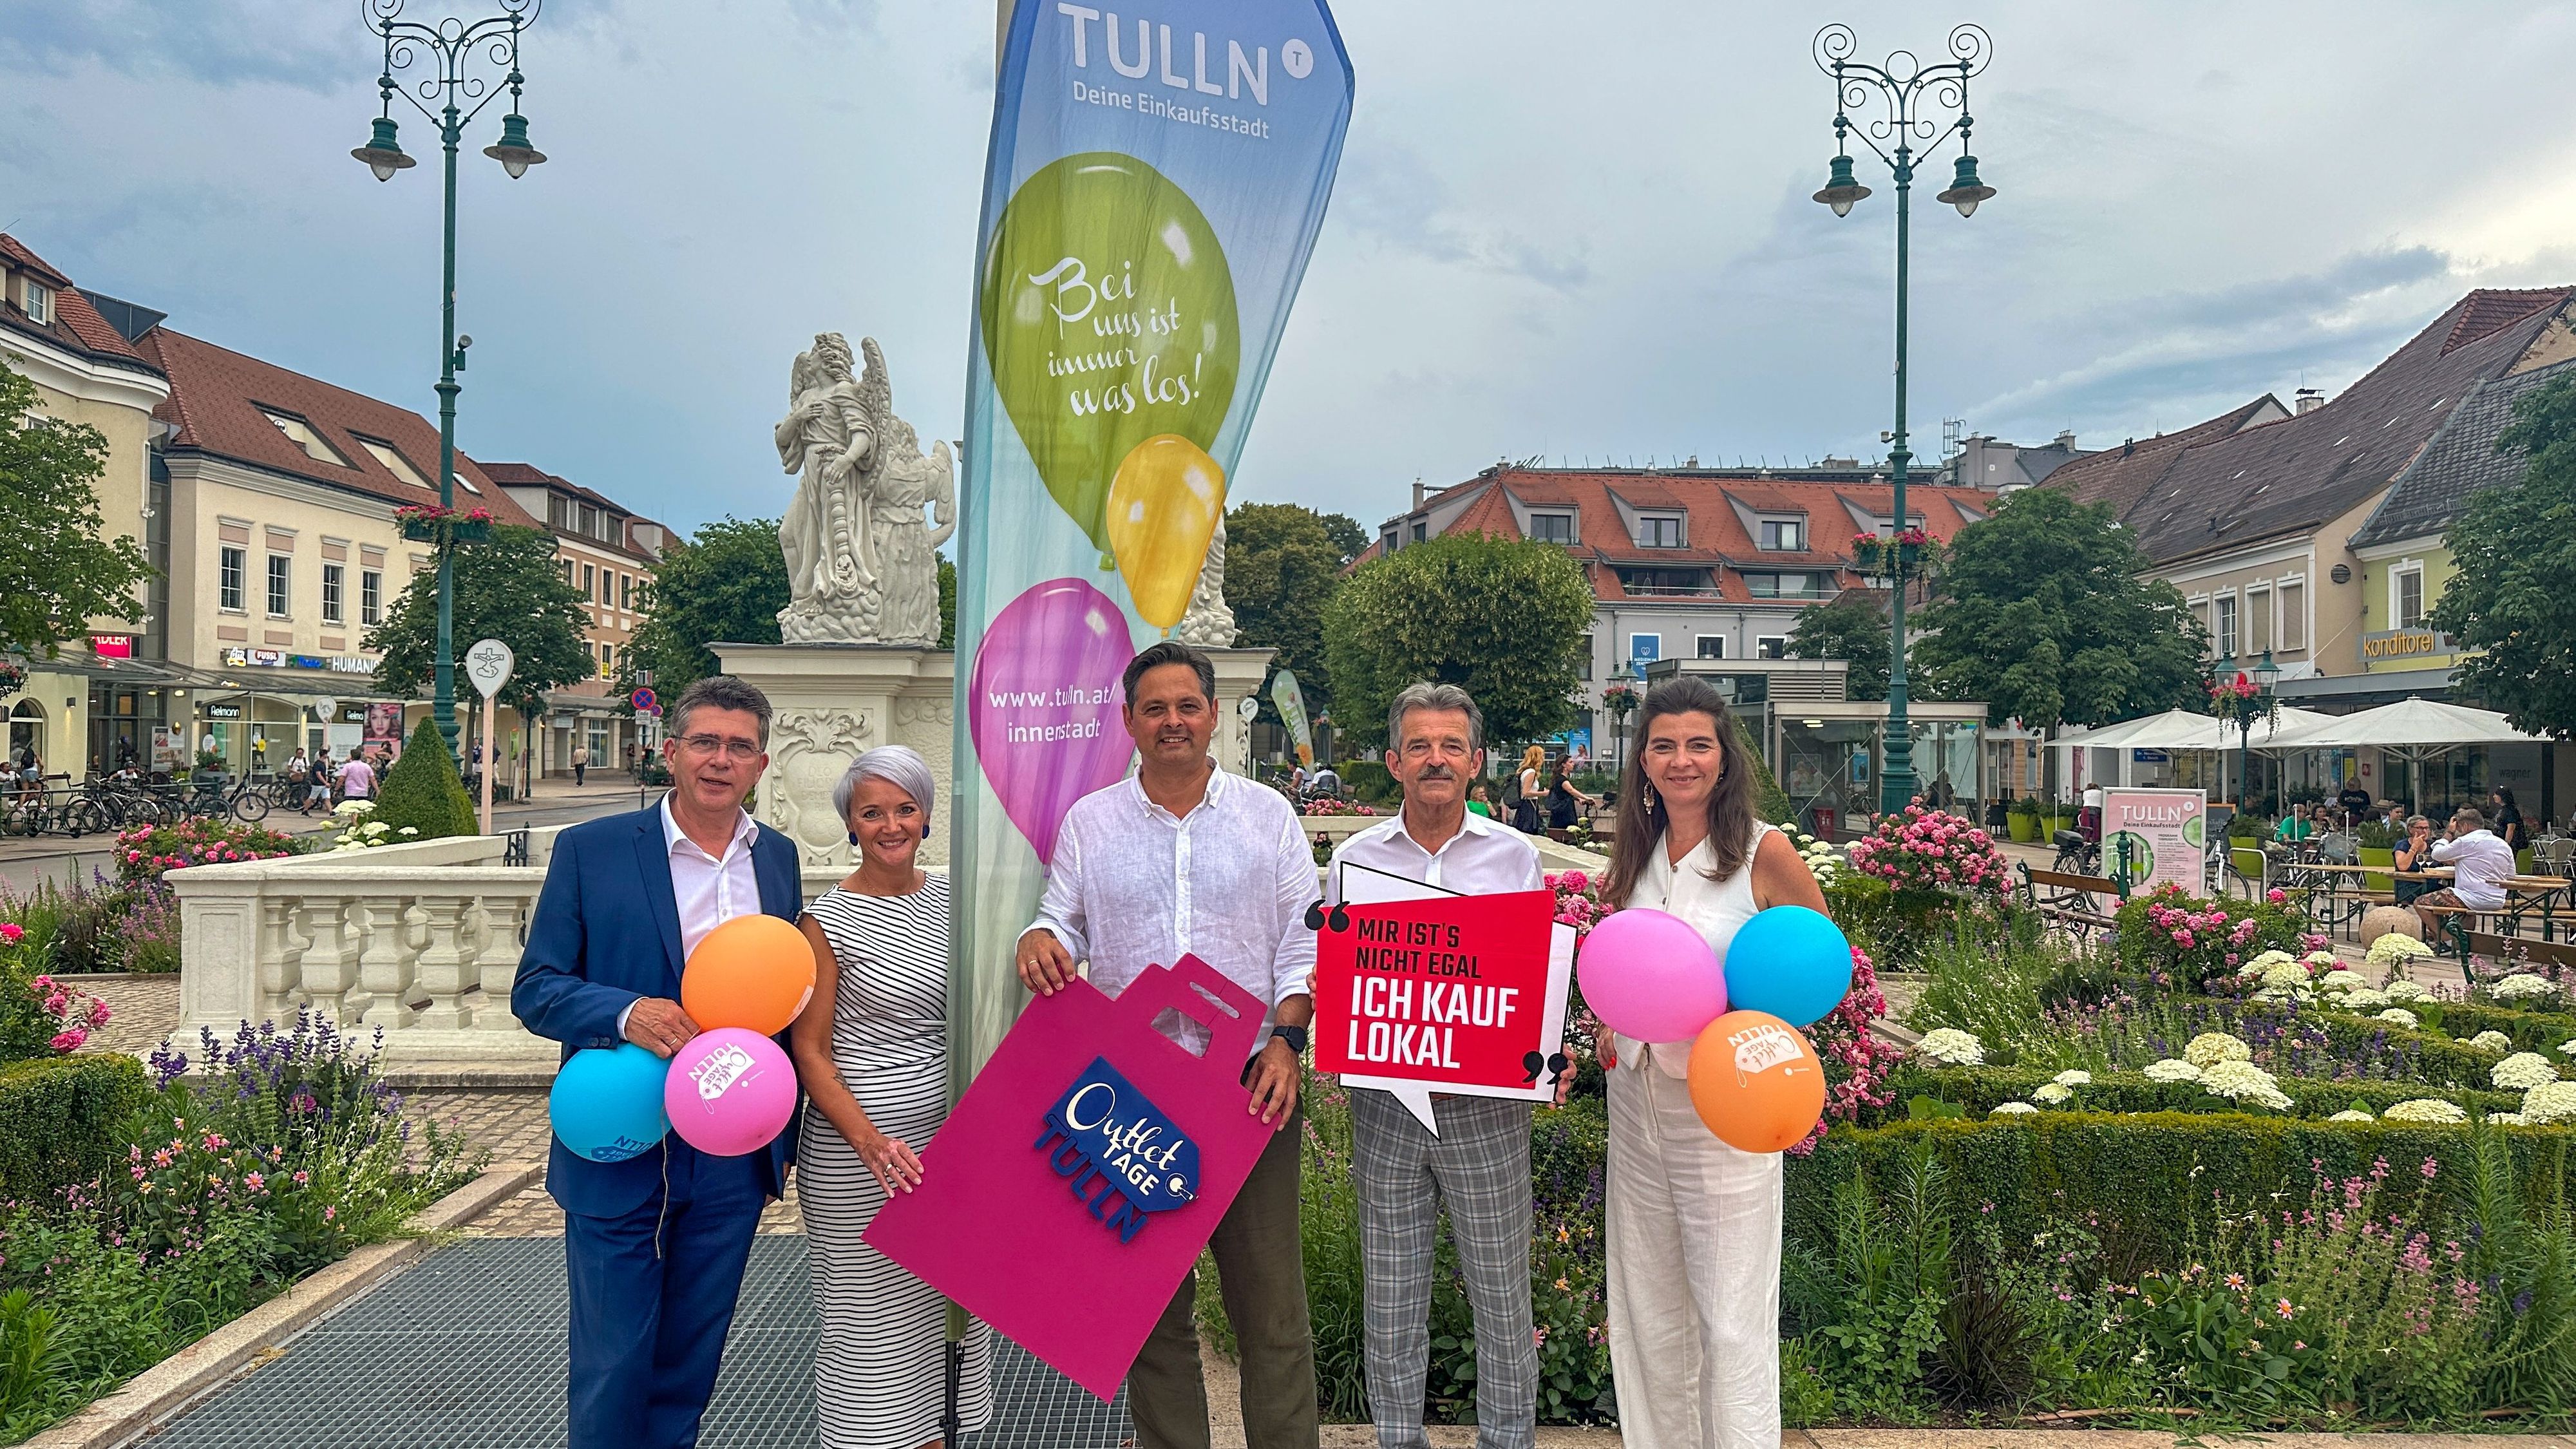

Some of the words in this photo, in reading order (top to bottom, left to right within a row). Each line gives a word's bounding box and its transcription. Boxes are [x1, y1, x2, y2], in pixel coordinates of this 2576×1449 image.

[1057, 2, 1268, 106] TULLN
[1293, 51, 1302, 66] T
[1074, 80, 1132, 109] Deine
[1138, 93, 1269, 139] Einkaufsstadt
[1028, 257, 1137, 340] Bei
[1094, 312, 1141, 337] uns
[1149, 296, 1181, 336] ist
[1046, 347, 1141, 377] immer
[1070, 383, 1135, 416] was
[1143, 353, 1202, 406] los!
[2363, 631, 2434, 657] konditorei
[211, 705, 240, 717] Fielmann
[989, 683, 1116, 708] www.tulln.at/
[1009, 718, 1101, 743] innerstadt
[2499, 769, 2531, 781] wagner
[2120, 805, 2181, 821] TULLN
[1357, 918, 1399, 943] MIR
[1406, 922, 1460, 948] IST'S
[1356, 946, 1422, 972] NICHT
[1428, 952, 1482, 978] EGAL
[1351, 975, 1412, 1020] ICH
[1421, 981, 1519, 1028] KAUF
[1347, 1020, 1461, 1069] LOKAL
[1727, 1024, 1783, 1047] TULLN
[1744, 1039, 1770, 1055] TAGE
[1752, 1035, 1795, 1068] Outlet
[687, 1042, 735, 1081] TULLN
[704, 1063, 725, 1086] TAGE
[712, 1051, 746, 1092] Outlet
[613, 1135, 654, 1151] ULLN
[1066, 1083, 1184, 1171] Outlet
[1034, 1113, 1148, 1244] TULLN
[1103, 1138, 1159, 1196] TAGE
